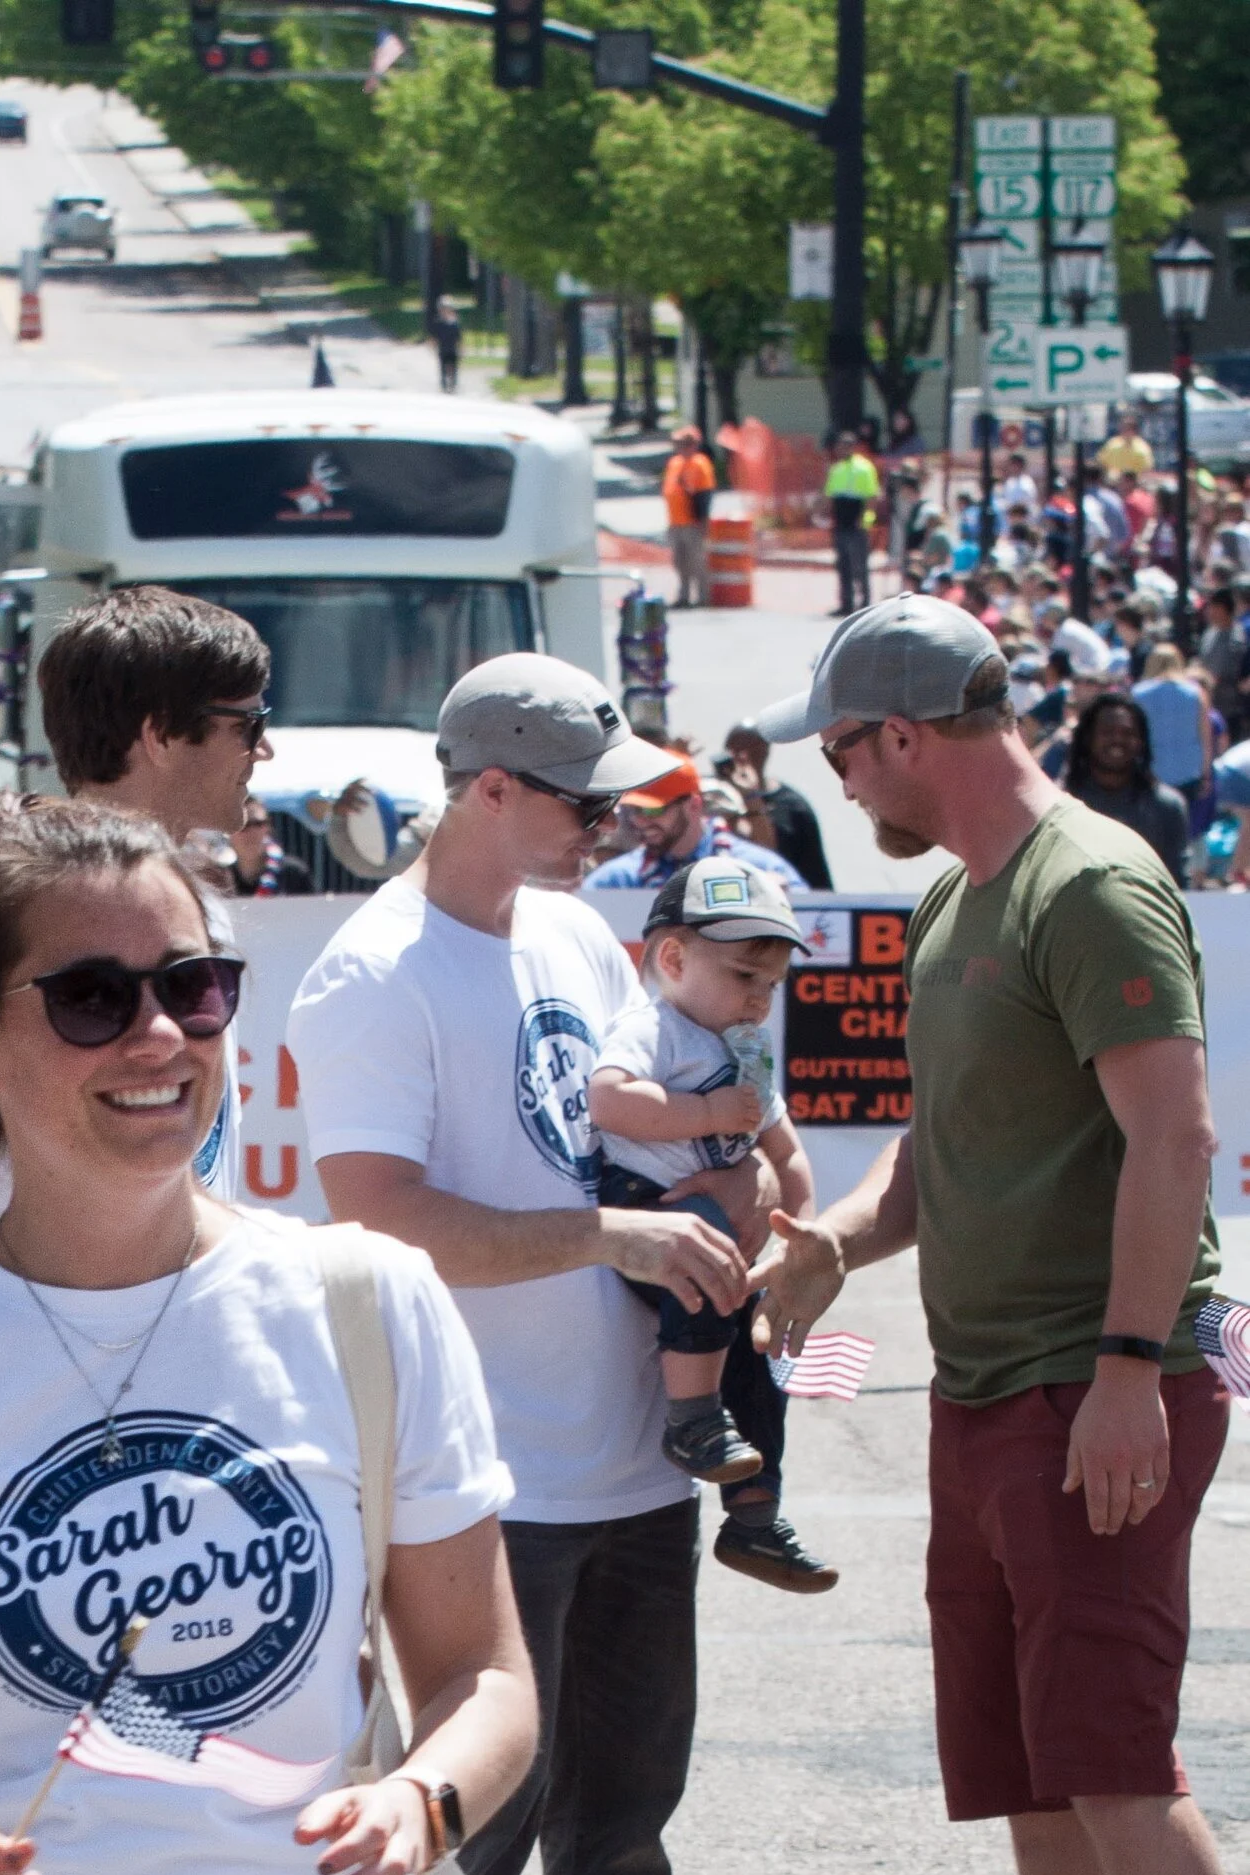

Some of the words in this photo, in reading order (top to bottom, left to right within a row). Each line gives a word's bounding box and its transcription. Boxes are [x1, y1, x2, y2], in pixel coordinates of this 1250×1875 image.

[993, 178, 1028, 216] 15
[1064, 178, 1103, 215] 117
[1048, 344, 1085, 393] P
[795, 973, 912, 1005] CENT
[789, 1091, 857, 1121] SAT
[186, 1442, 281, 1513] COUNTY
[74, 1523, 316, 1668] George
[171, 1618, 234, 1643] 2018
[157, 1634, 286, 1704] ATTORNEY
